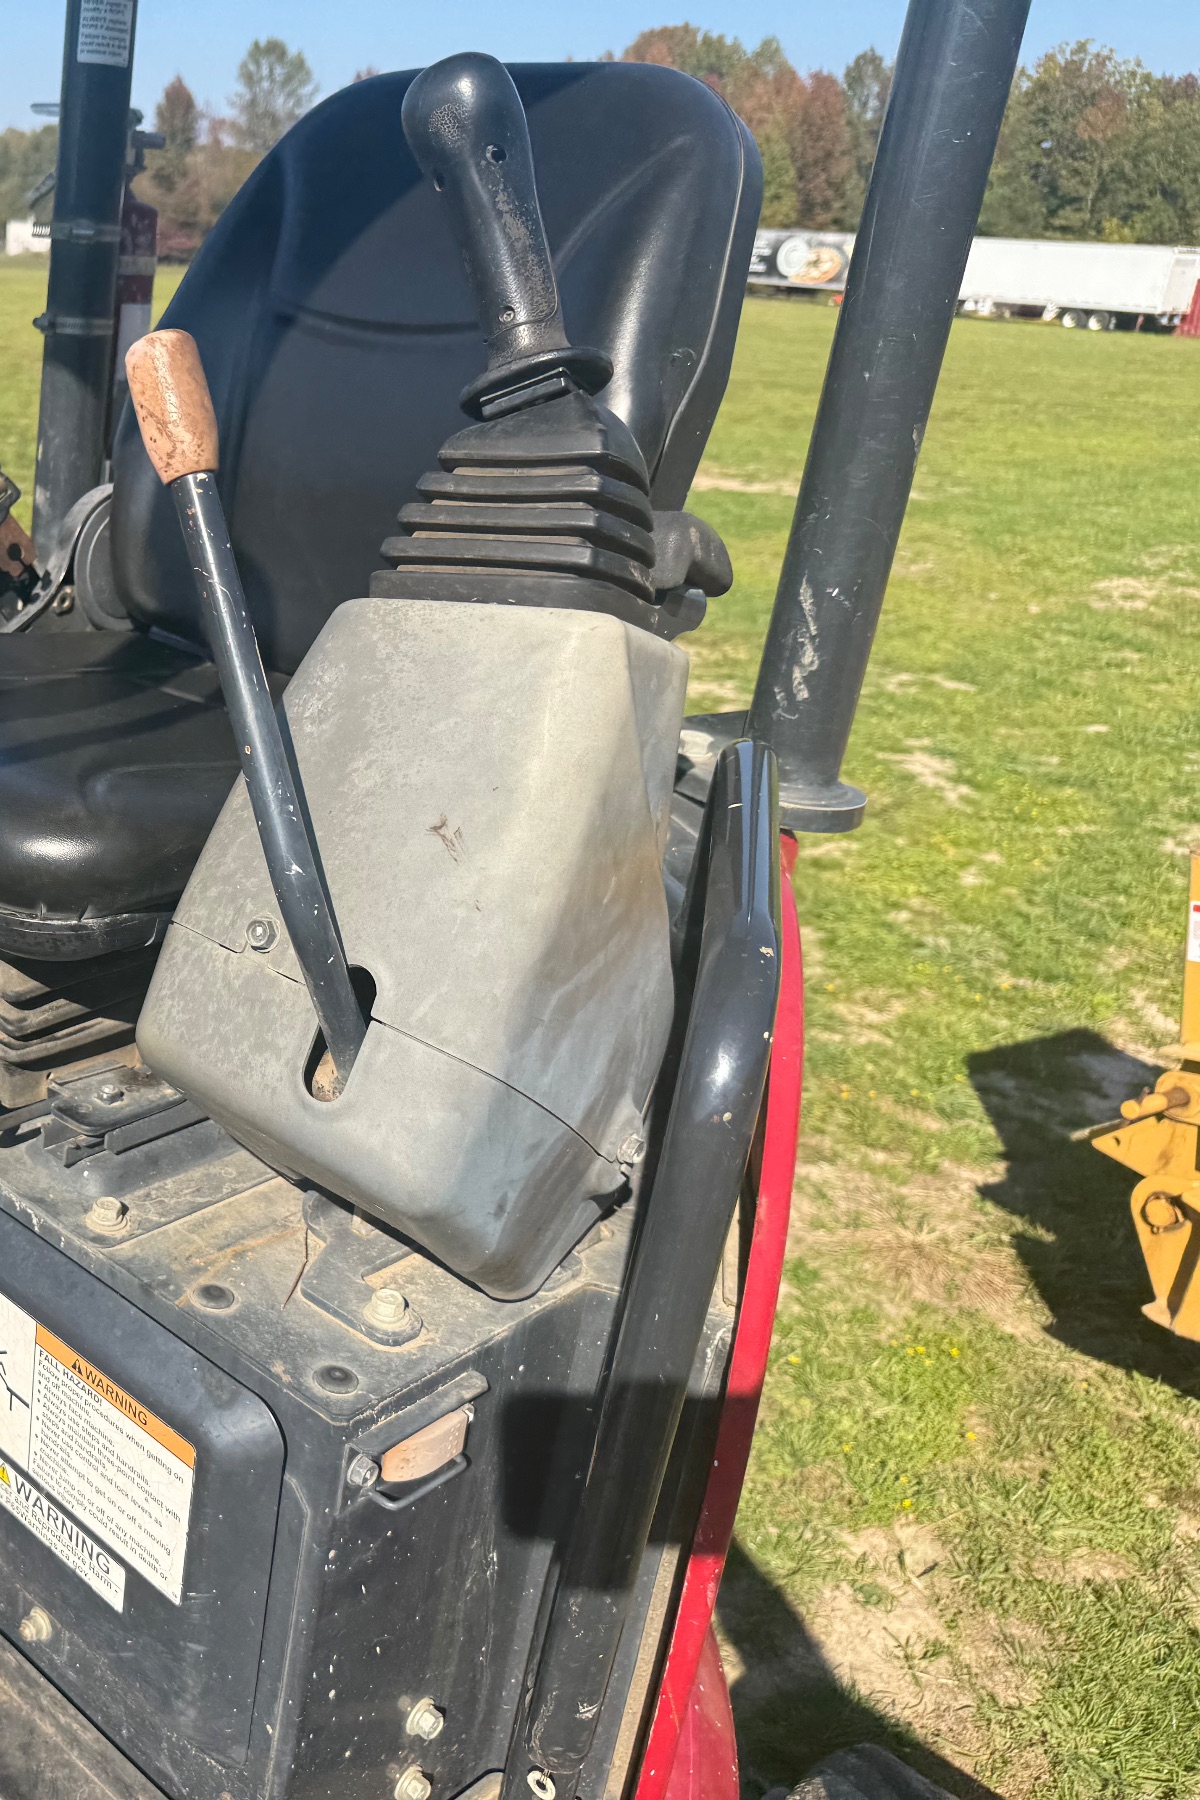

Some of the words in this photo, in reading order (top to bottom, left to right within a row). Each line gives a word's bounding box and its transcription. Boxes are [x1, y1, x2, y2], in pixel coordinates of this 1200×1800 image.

[39, 1348, 60, 1373] FALL
[62, 1367, 102, 1407] HAZARD!
[84, 1365, 147, 1427] WARNING
[13, 1474, 111, 1577] WARNING
[14, 1494, 29, 1514] and
[30, 1508, 86, 1567] Reproductive
[88, 1561, 112, 1590] Harm
